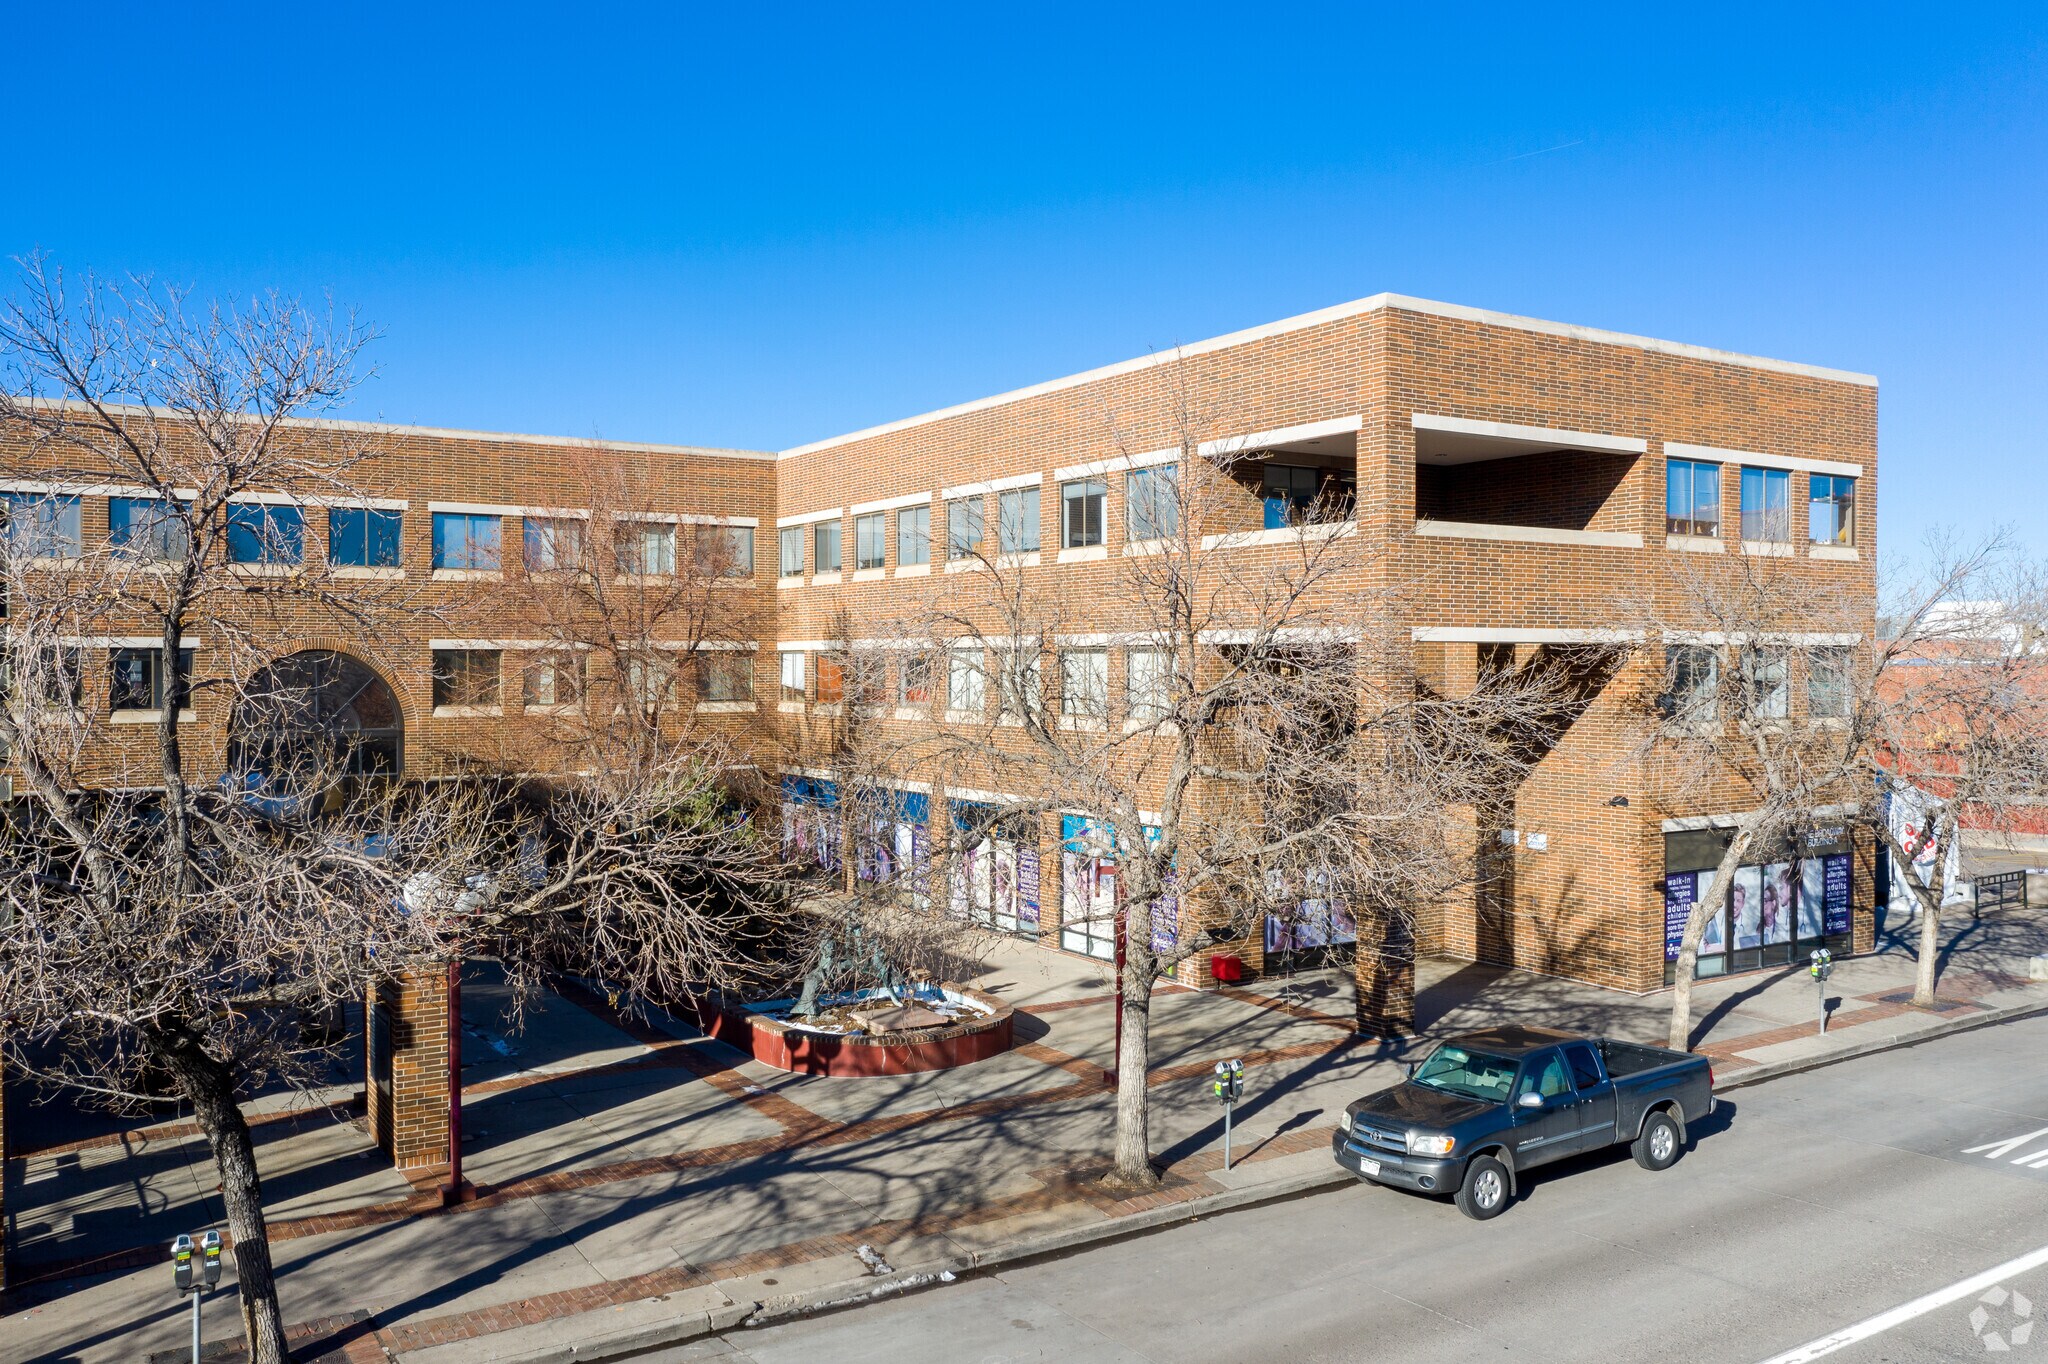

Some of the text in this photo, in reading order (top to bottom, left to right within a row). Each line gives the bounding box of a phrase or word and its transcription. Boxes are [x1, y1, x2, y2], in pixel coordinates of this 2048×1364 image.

[1827, 858, 1847, 867] walk-in
[1667, 876, 1691, 886] walk-in
[1827, 882, 1847, 892] adults
[1667, 904, 1691, 914] adults
[1667, 930, 1684, 940] physic
